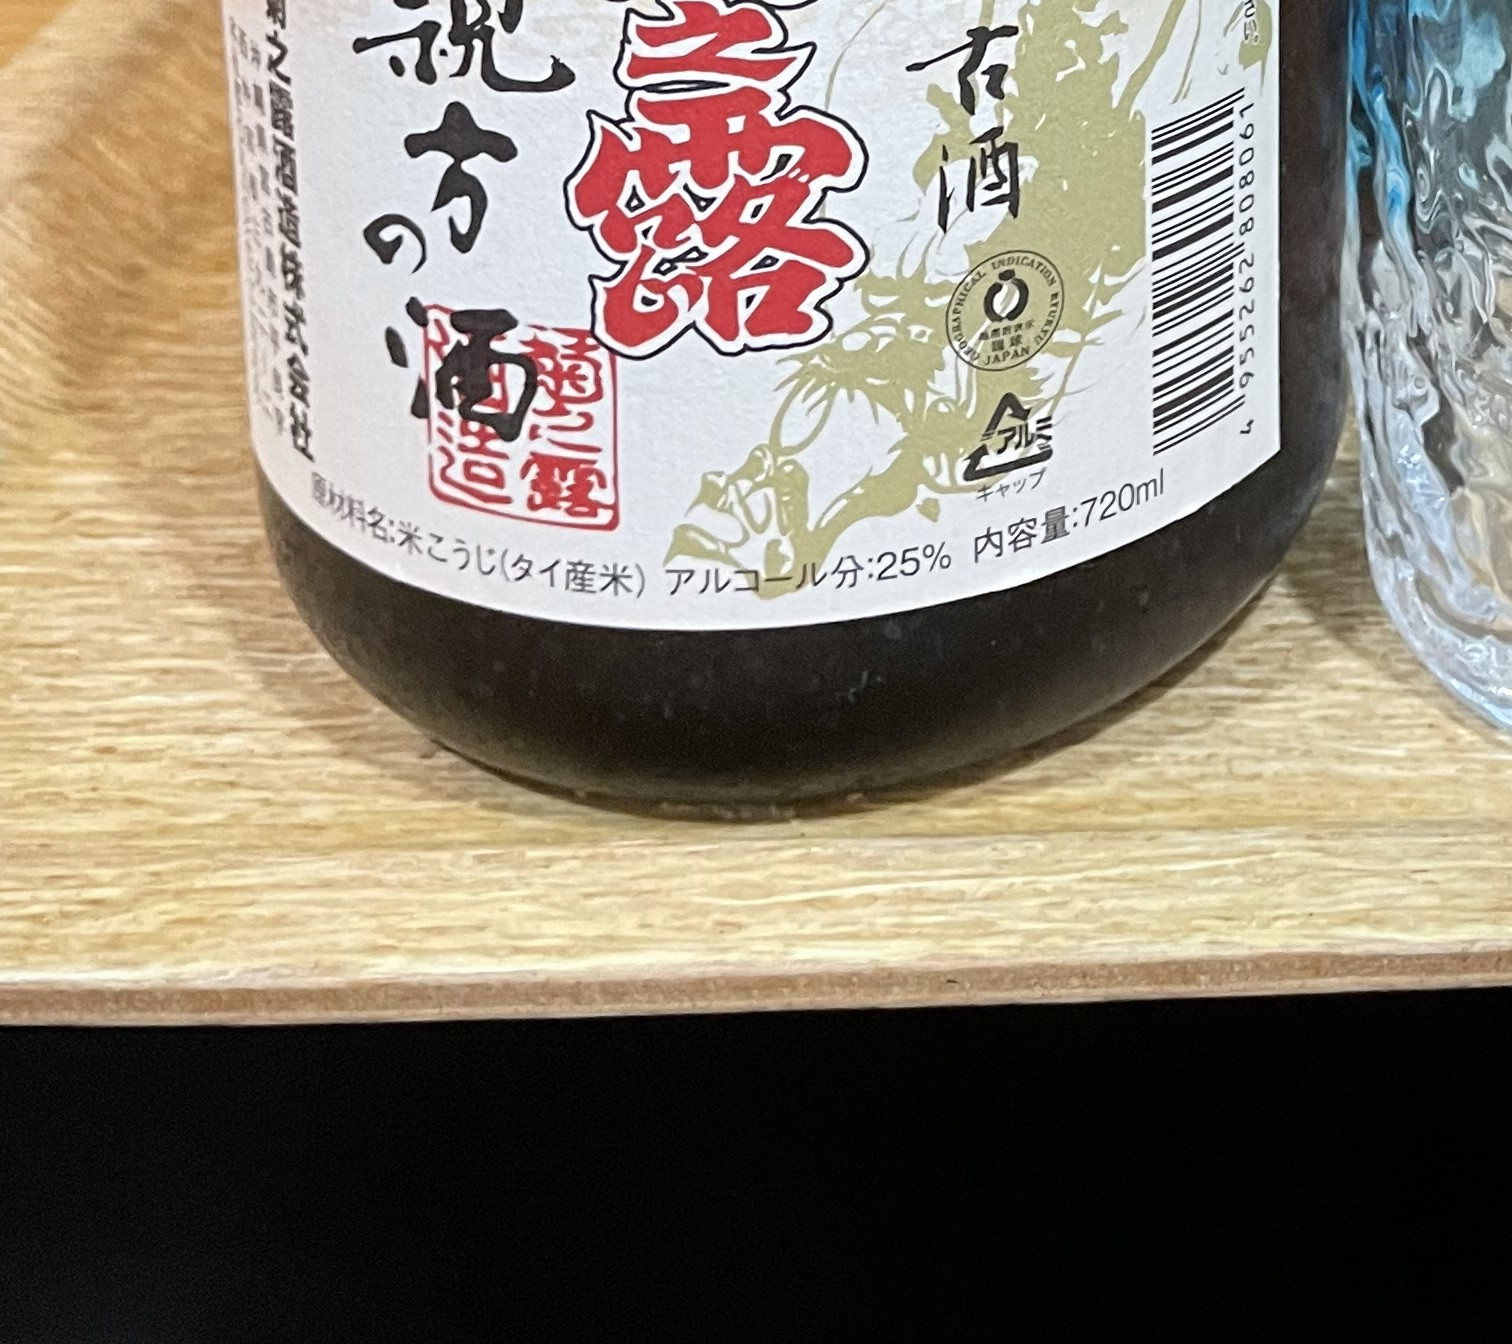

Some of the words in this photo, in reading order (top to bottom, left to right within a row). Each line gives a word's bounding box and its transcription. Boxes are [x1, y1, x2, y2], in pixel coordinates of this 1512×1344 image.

[983, 346, 1031, 366] JAPAN
[996, 416, 1053, 454] アルミ
[976, 468, 1048, 502] キャップ
